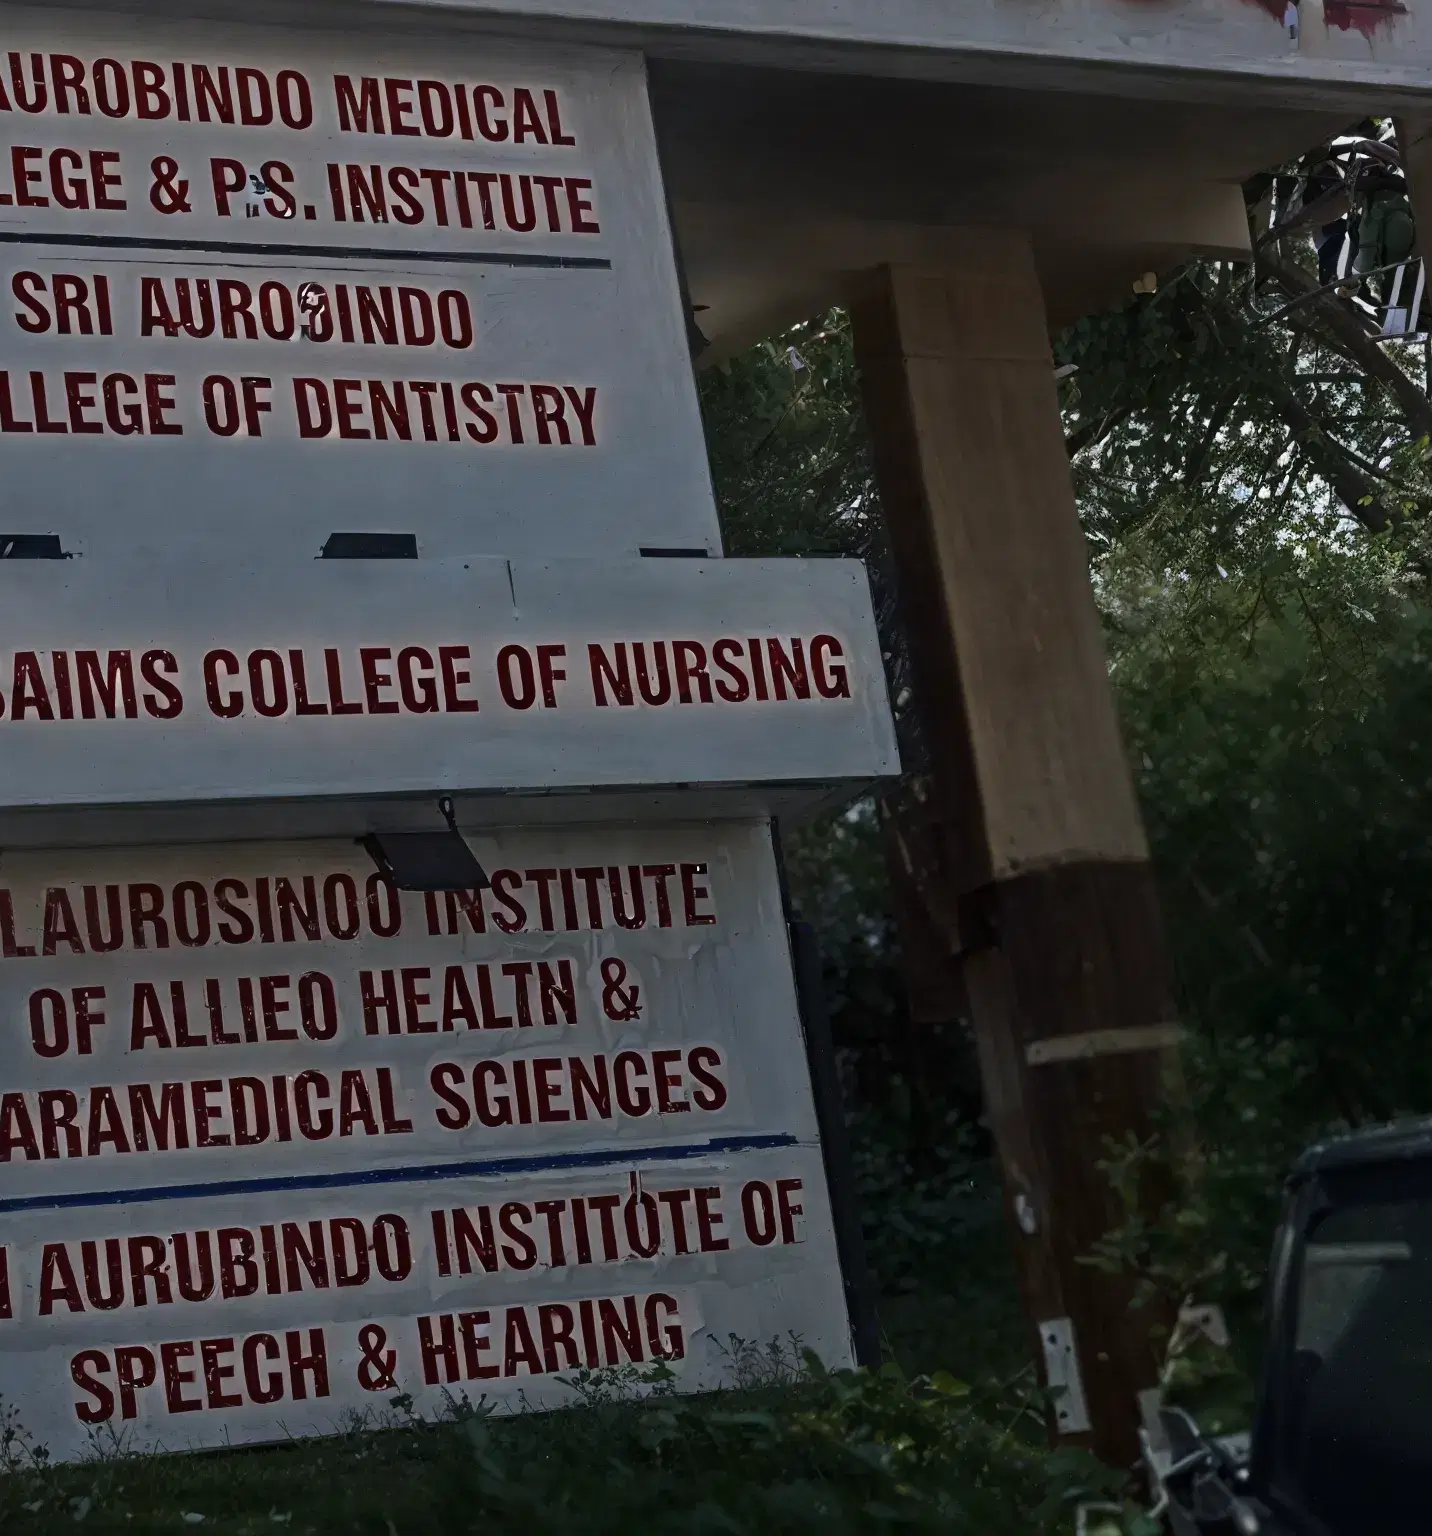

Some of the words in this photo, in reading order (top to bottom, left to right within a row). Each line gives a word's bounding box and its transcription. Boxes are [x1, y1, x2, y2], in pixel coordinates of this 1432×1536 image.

[331, 72, 576, 148] MEDICAL
[148, 153, 194, 217] &
[326, 161, 598, 235] INSTITUTE
[10, 270, 115, 335] SRI
[200, 372, 272, 438] OF
[291, 374, 597, 447] DENTISTRY
[201, 642, 481, 721] COLLEGE
[495, 641, 568, 712] OF
[585, 630, 851, 707] NURSING
[423, 863, 717, 938] INSTITUTE
[29, 985, 107, 1060] OF
[601, 957, 643, 1021] &
[740, 1178, 807, 1246] OF
[70, 1327, 330, 1424] SPEECH
[357, 1323, 399, 1392] &
[417, 1292, 684, 1386] HEARING
